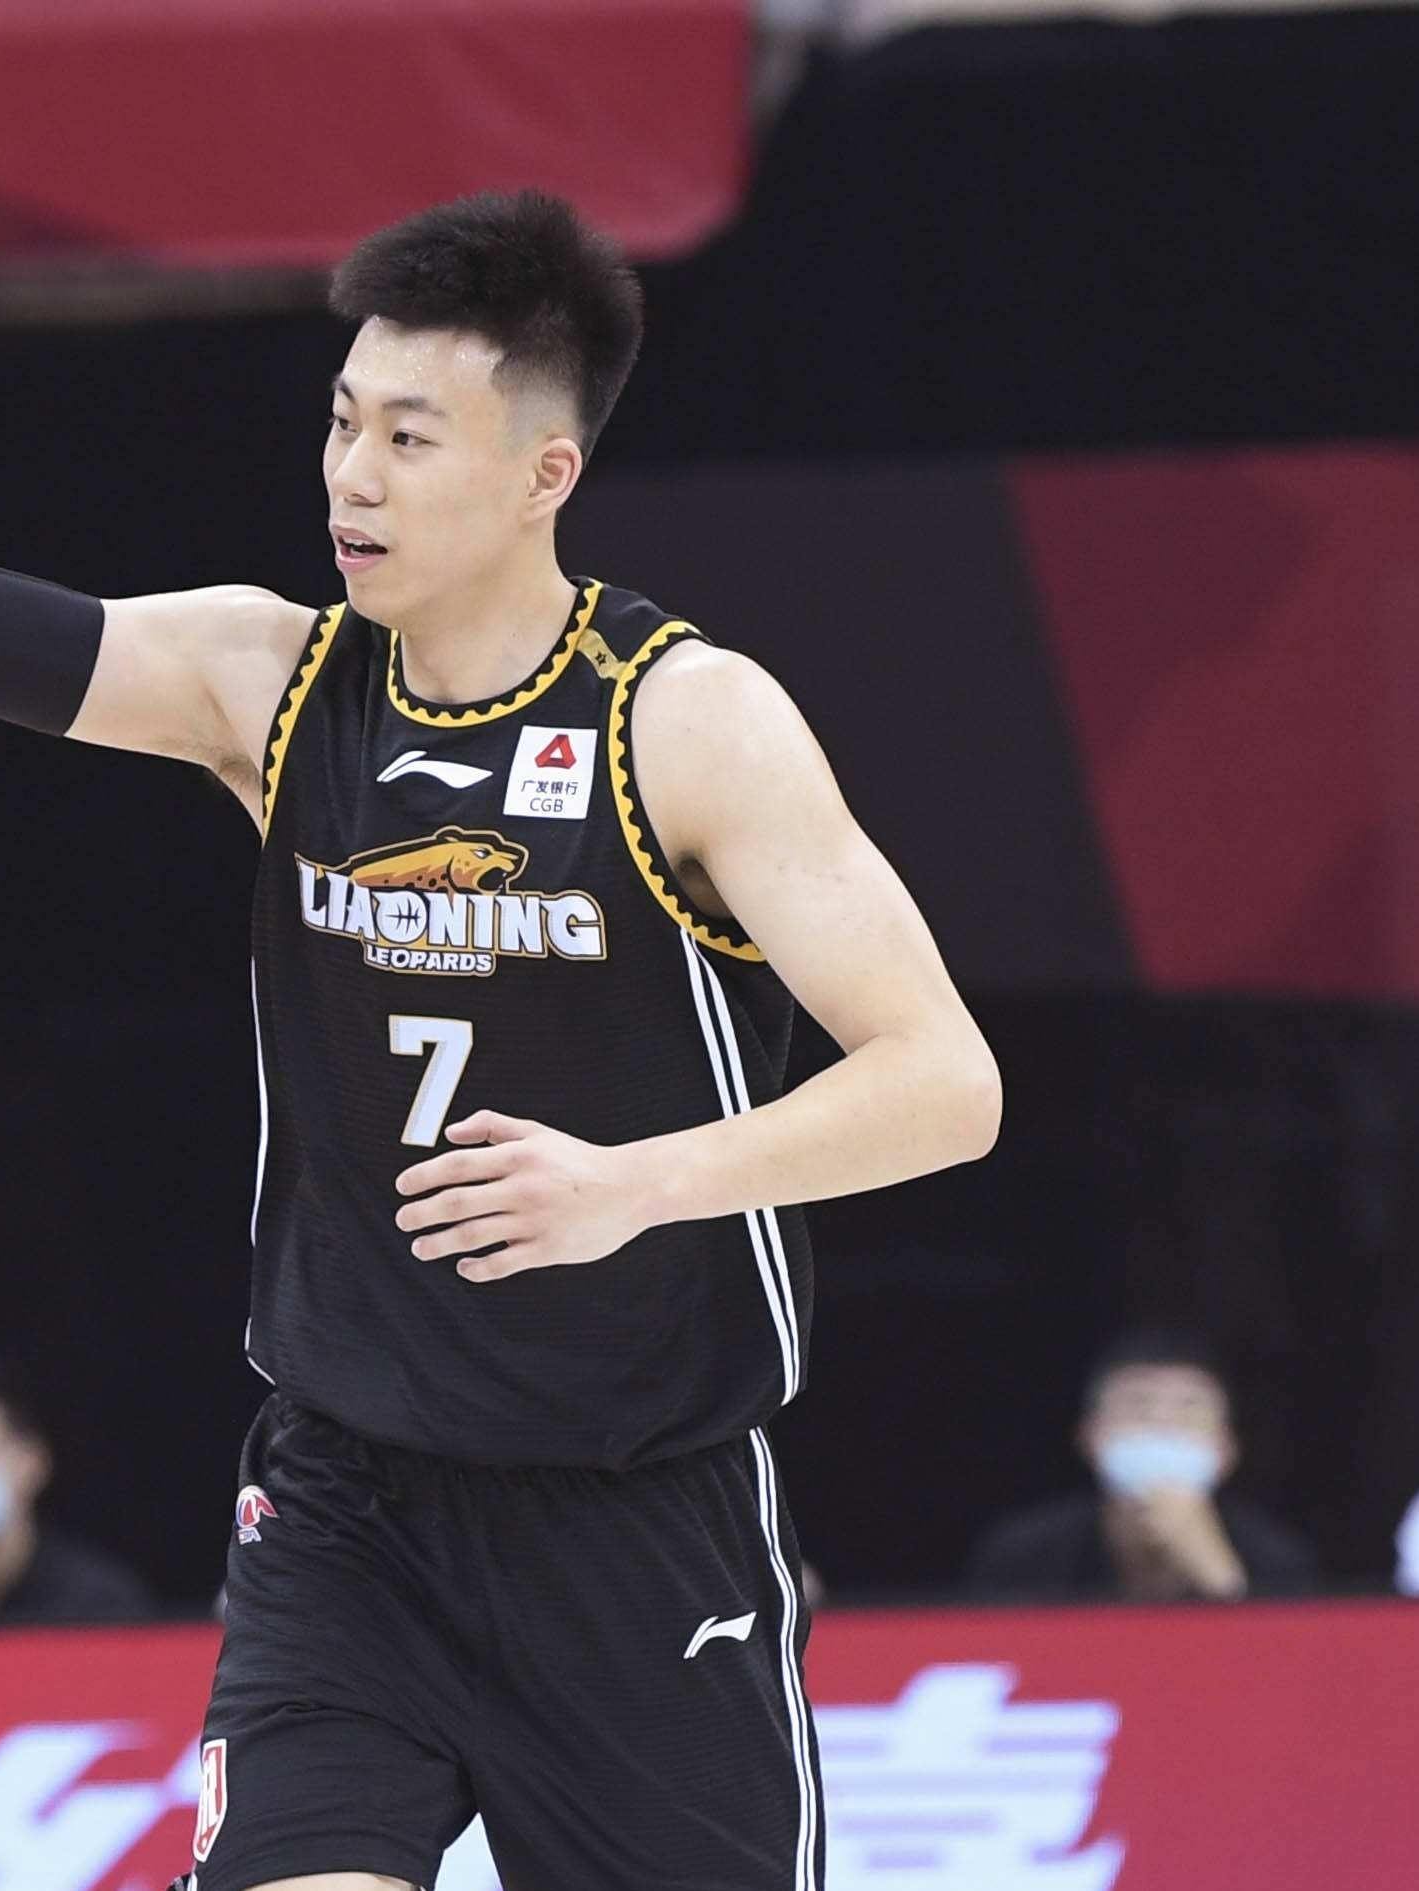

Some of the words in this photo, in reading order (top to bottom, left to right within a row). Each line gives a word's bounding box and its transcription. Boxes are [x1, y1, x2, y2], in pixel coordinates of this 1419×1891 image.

[521, 780, 579, 795] 广发银行
[529, 797, 564, 813] CGB
[299, 861, 603, 956] LIAONING
[366, 944, 493, 973] LEOPARDS
[388, 1014, 473, 1147] 7
